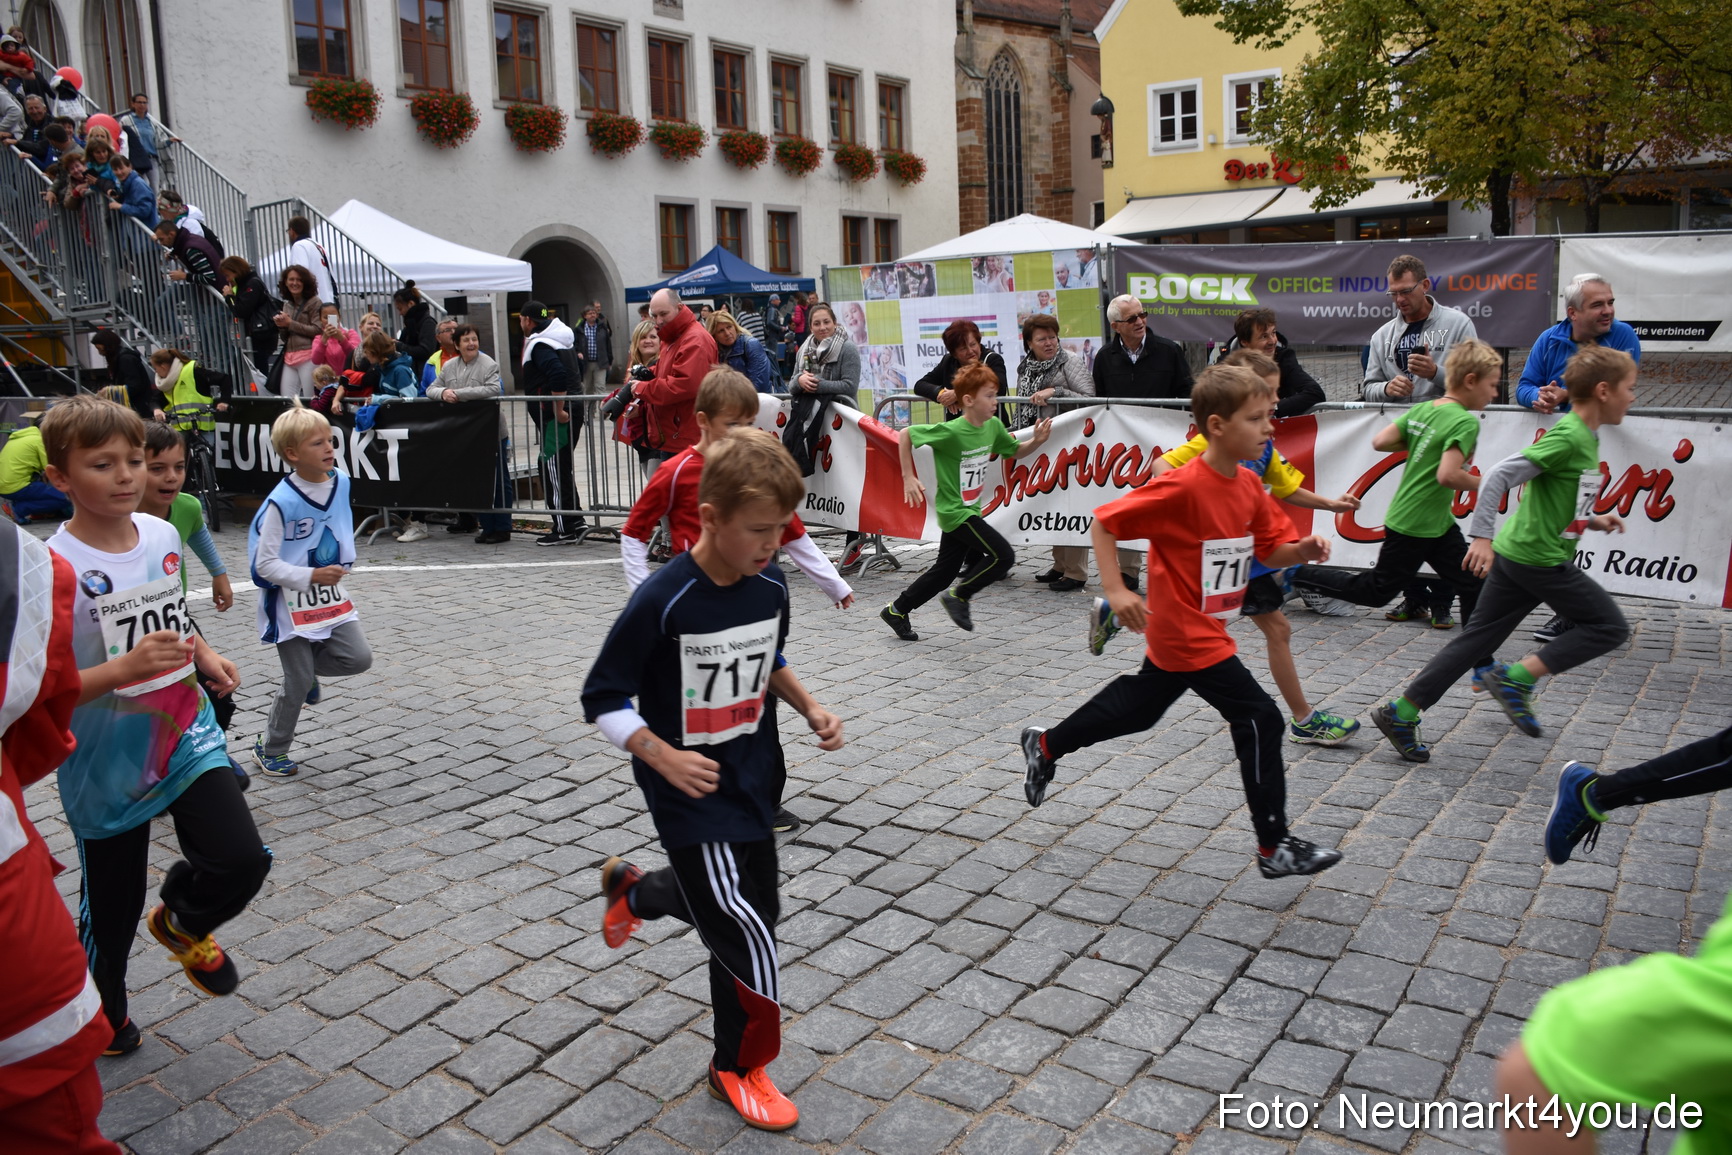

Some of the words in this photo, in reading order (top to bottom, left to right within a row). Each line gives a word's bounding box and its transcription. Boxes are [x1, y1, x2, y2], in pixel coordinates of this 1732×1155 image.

[1223, 159, 1269, 182] Der
[1129, 276, 1252, 301] BOCK
[1267, 276, 1333, 293] OFFICE
[1339, 276, 1443, 293] INDUY
[1447, 273, 1538, 292] LOUNGE
[1167, 306, 1181, 317] by
[1182, 307, 1211, 316] smart
[1633, 327, 1648, 336] die
[1650, 327, 1705, 336] verbinden
[214, 422, 409, 482] EUMRKT
[805, 492, 845, 516] Radio
[284, 516, 315, 541] 13
[1018, 511, 1094, 535] Ostbay
[1204, 547, 1233, 556] PARTL
[1603, 549, 1699, 584] Radio
[289, 583, 342, 608] 7050
[101, 599, 141, 617] PARTL
[303, 607, 342, 623] Christoph
[116, 597, 191, 652] 7063
[684, 645, 727, 657] PARTL
[696, 652, 766, 702] 717
